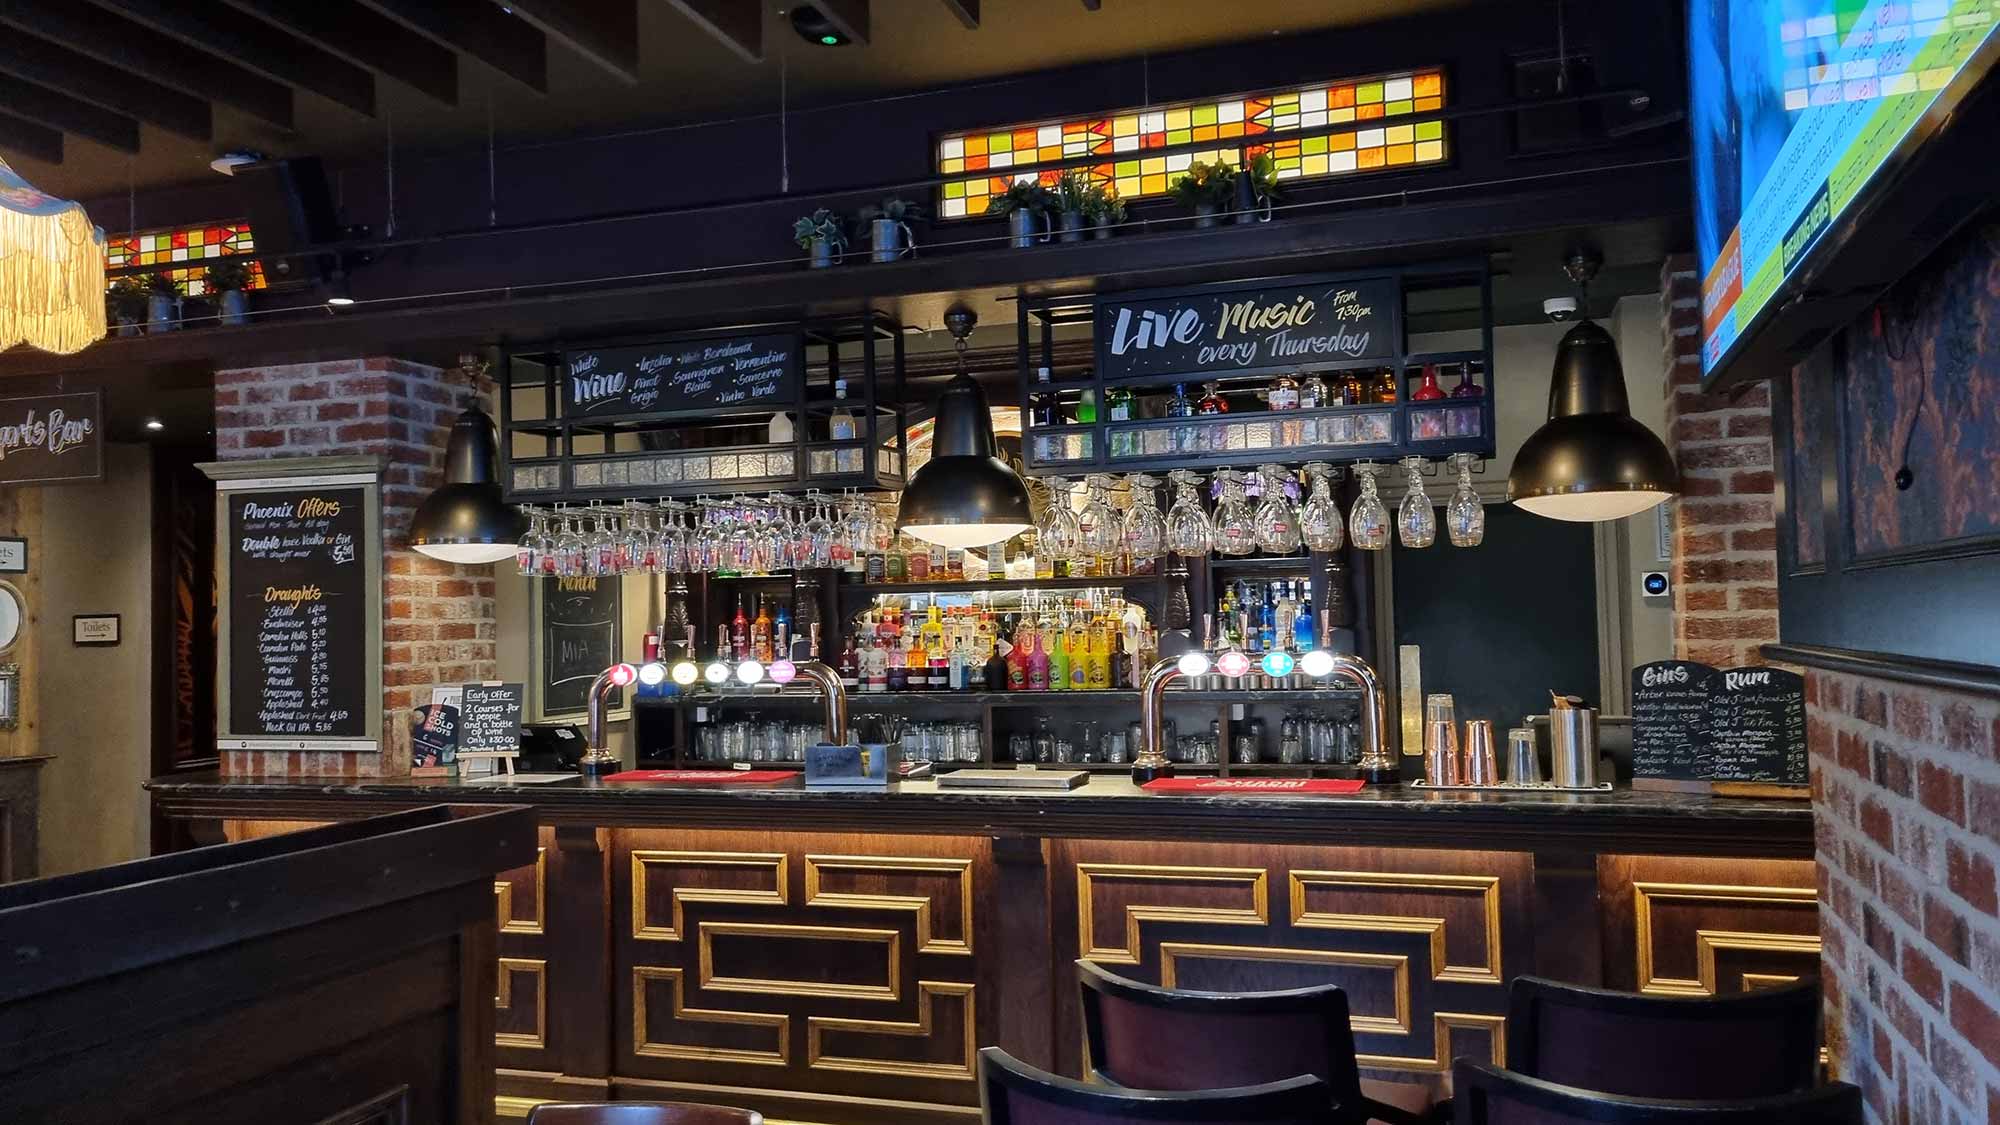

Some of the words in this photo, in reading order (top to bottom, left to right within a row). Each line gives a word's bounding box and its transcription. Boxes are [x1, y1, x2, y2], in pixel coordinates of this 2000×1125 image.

[1333, 290, 1357, 306] From
[1112, 307, 1204, 355] Live
[1216, 296, 1316, 340] Music
[703, 342, 753, 360] Bordeaux
[1197, 340, 1257, 366] every
[1265, 324, 1370, 357] Thursday
[571, 354, 599, 376] White
[735, 350, 787, 371] Vermentino
[673, 365, 725, 384] Sauvignon
[737, 368, 783, 385] Sancerre
[634, 374, 662, 390] Pinot
[573, 372, 627, 405] Wine
[720, 390, 745, 403] Vinho
[752, 382, 776, 397] Verde
[629, 388, 660, 406] Grigio
[48, 408, 94, 455] Bar
[243, 502, 294, 520] Phoenix
[297, 497, 340, 519] Offers
[242, 536, 280, 552] Double
[302, 533, 325, 546] Vodka
[325, 536, 334, 545] or
[335, 533, 352, 544] Gin
[264, 584, 321, 610] Draughts
[268, 606, 294, 618] Stella
[82, 621, 111, 633] Toilets
[263, 619, 304, 629] Budweiser
[260, 631, 289, 642] Camden
[291, 631, 308, 641] Hells
[259, 643, 288, 653] Camden
[290, 641, 307, 652] Pale
[264, 654, 298, 664] Guinness
[266, 676, 294, 686] Moretti
[1642, 665, 1690, 687] Gins
[1725, 671, 1770, 690] Rum
[263, 688, 303, 700] Cruzcampo
[466, 690, 488, 703] Early
[1713, 695, 1730, 704] Old
[1730, 694, 1740, 704] J
[265, 699, 304, 710] Appleshed
[465, 704, 472, 713] 2
[506, 703, 520, 714] for
[259, 710, 294, 721] Appleshed
[430, 709, 447, 720] ICE
[476, 712, 502, 722] people
[1731, 706, 1741, 717] J
[265, 722, 285, 732] Neck
[286, 722, 296, 732] Oil
[298, 722, 310, 732] IPA
[428, 716, 454, 730] COLD
[463, 721, 480, 729] and
[491, 720, 513, 728] bottle
[1713, 719, 1730, 728] Old
[1731, 716, 1742, 727] J
[471, 728, 482, 738] of
[466, 736, 486, 746] Only
